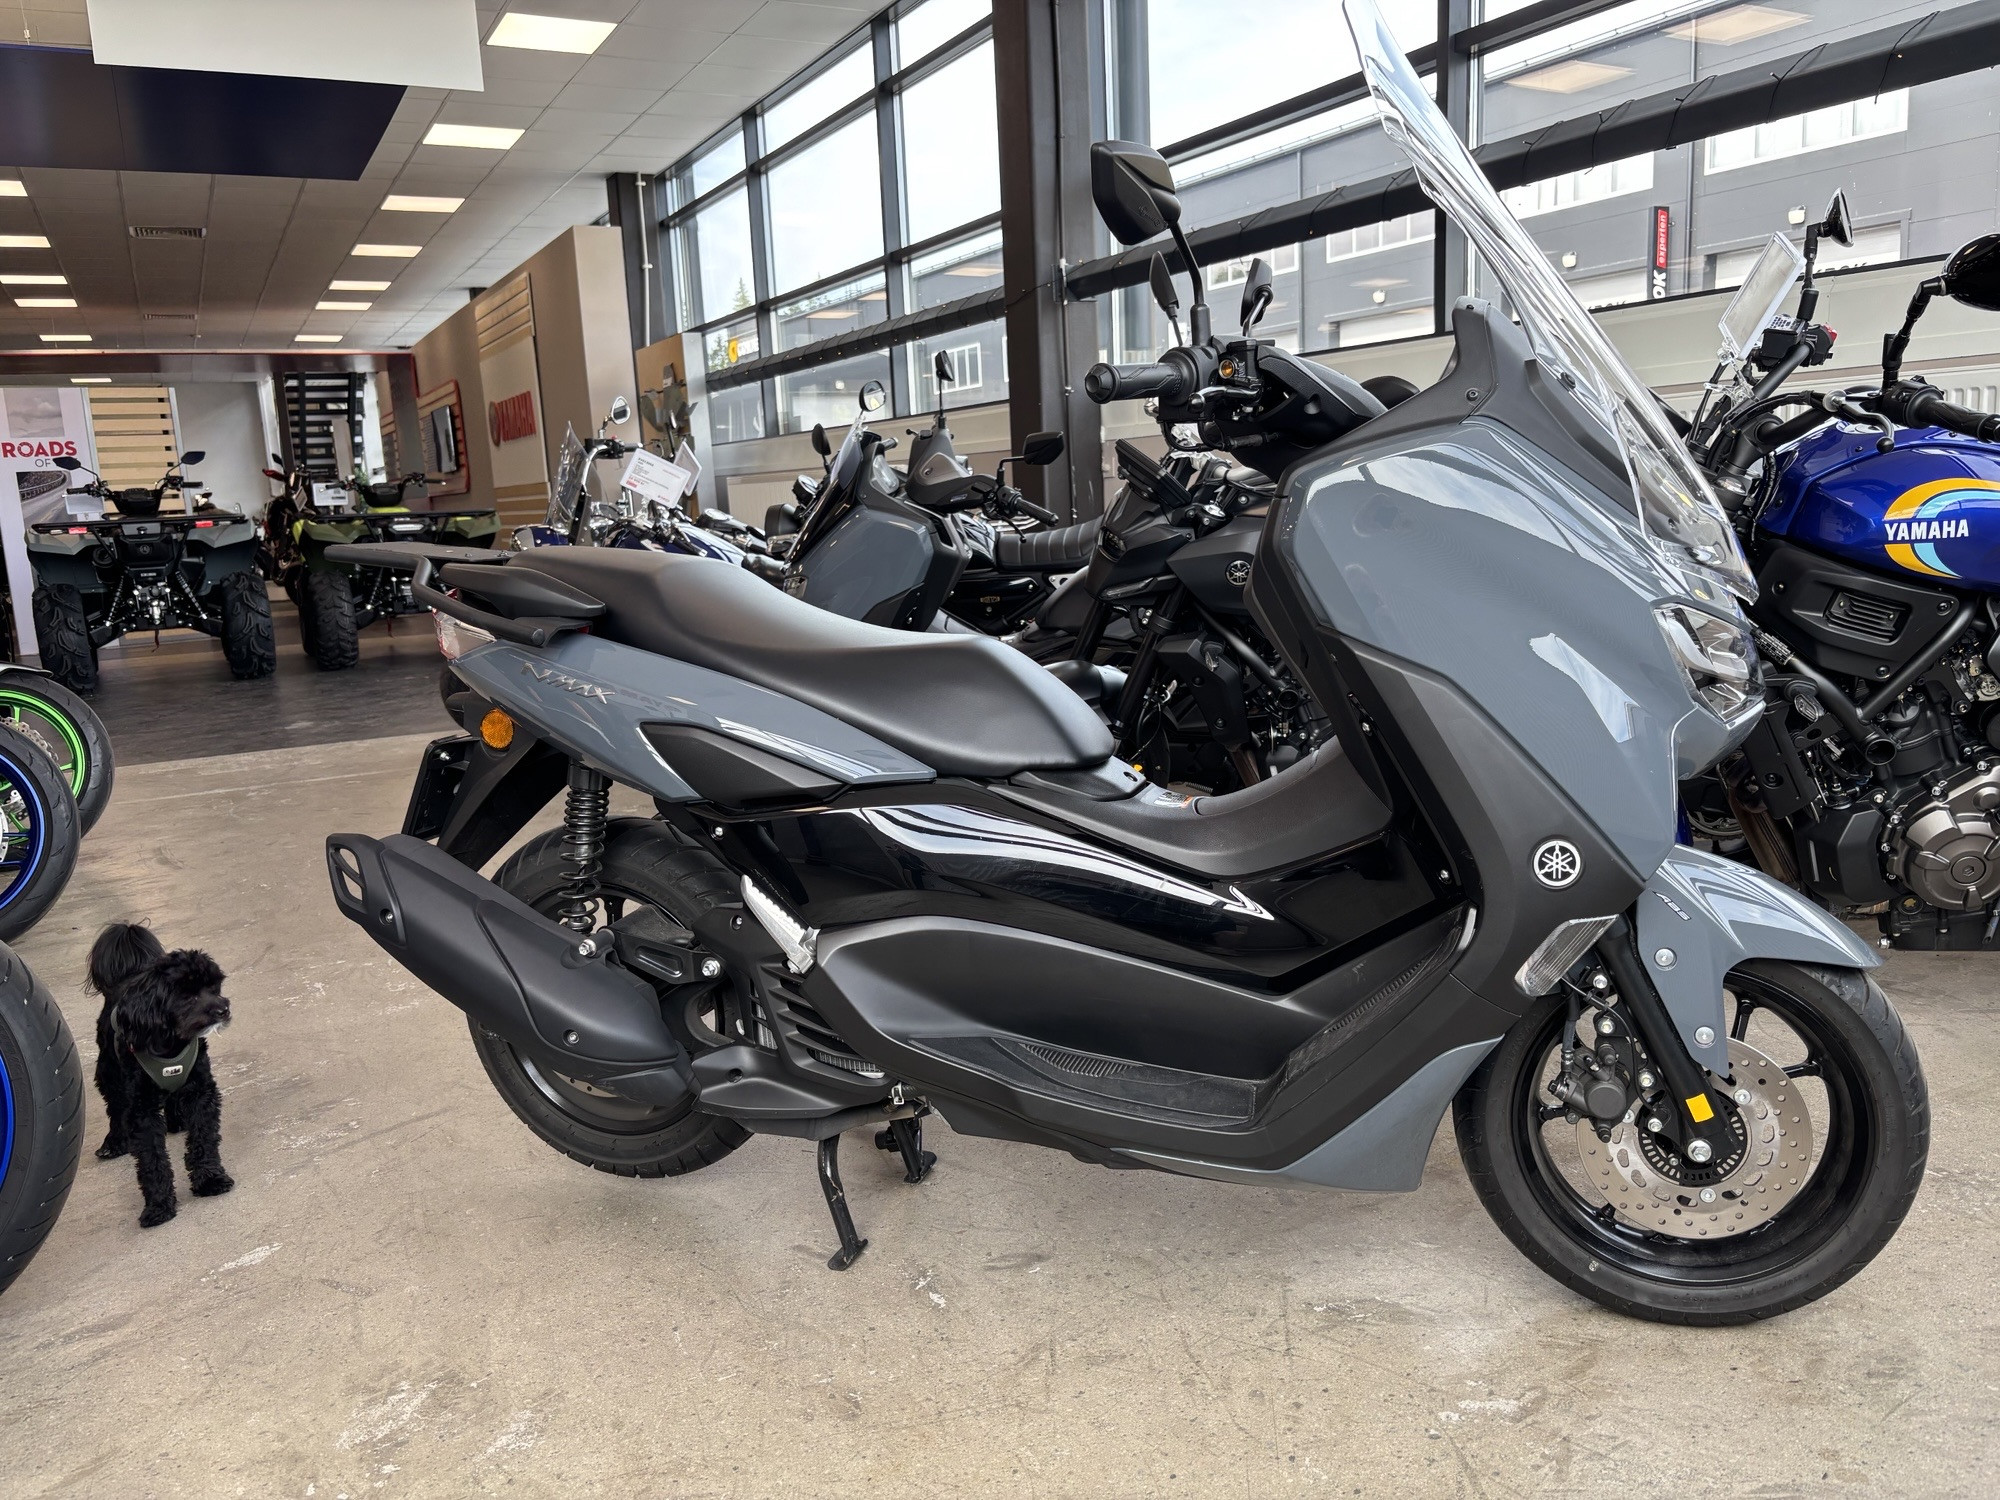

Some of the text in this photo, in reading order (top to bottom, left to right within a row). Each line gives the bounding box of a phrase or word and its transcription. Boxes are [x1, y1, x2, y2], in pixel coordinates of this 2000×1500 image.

[1659, 214, 1667, 264] experten
[496, 391, 537, 442] YAMAHA
[1, 441, 77, 458] ROADS
[35, 458, 51, 468] OF
[1884, 519, 1969, 541] YAMAHA
[1652, 891, 1692, 921] ABS
